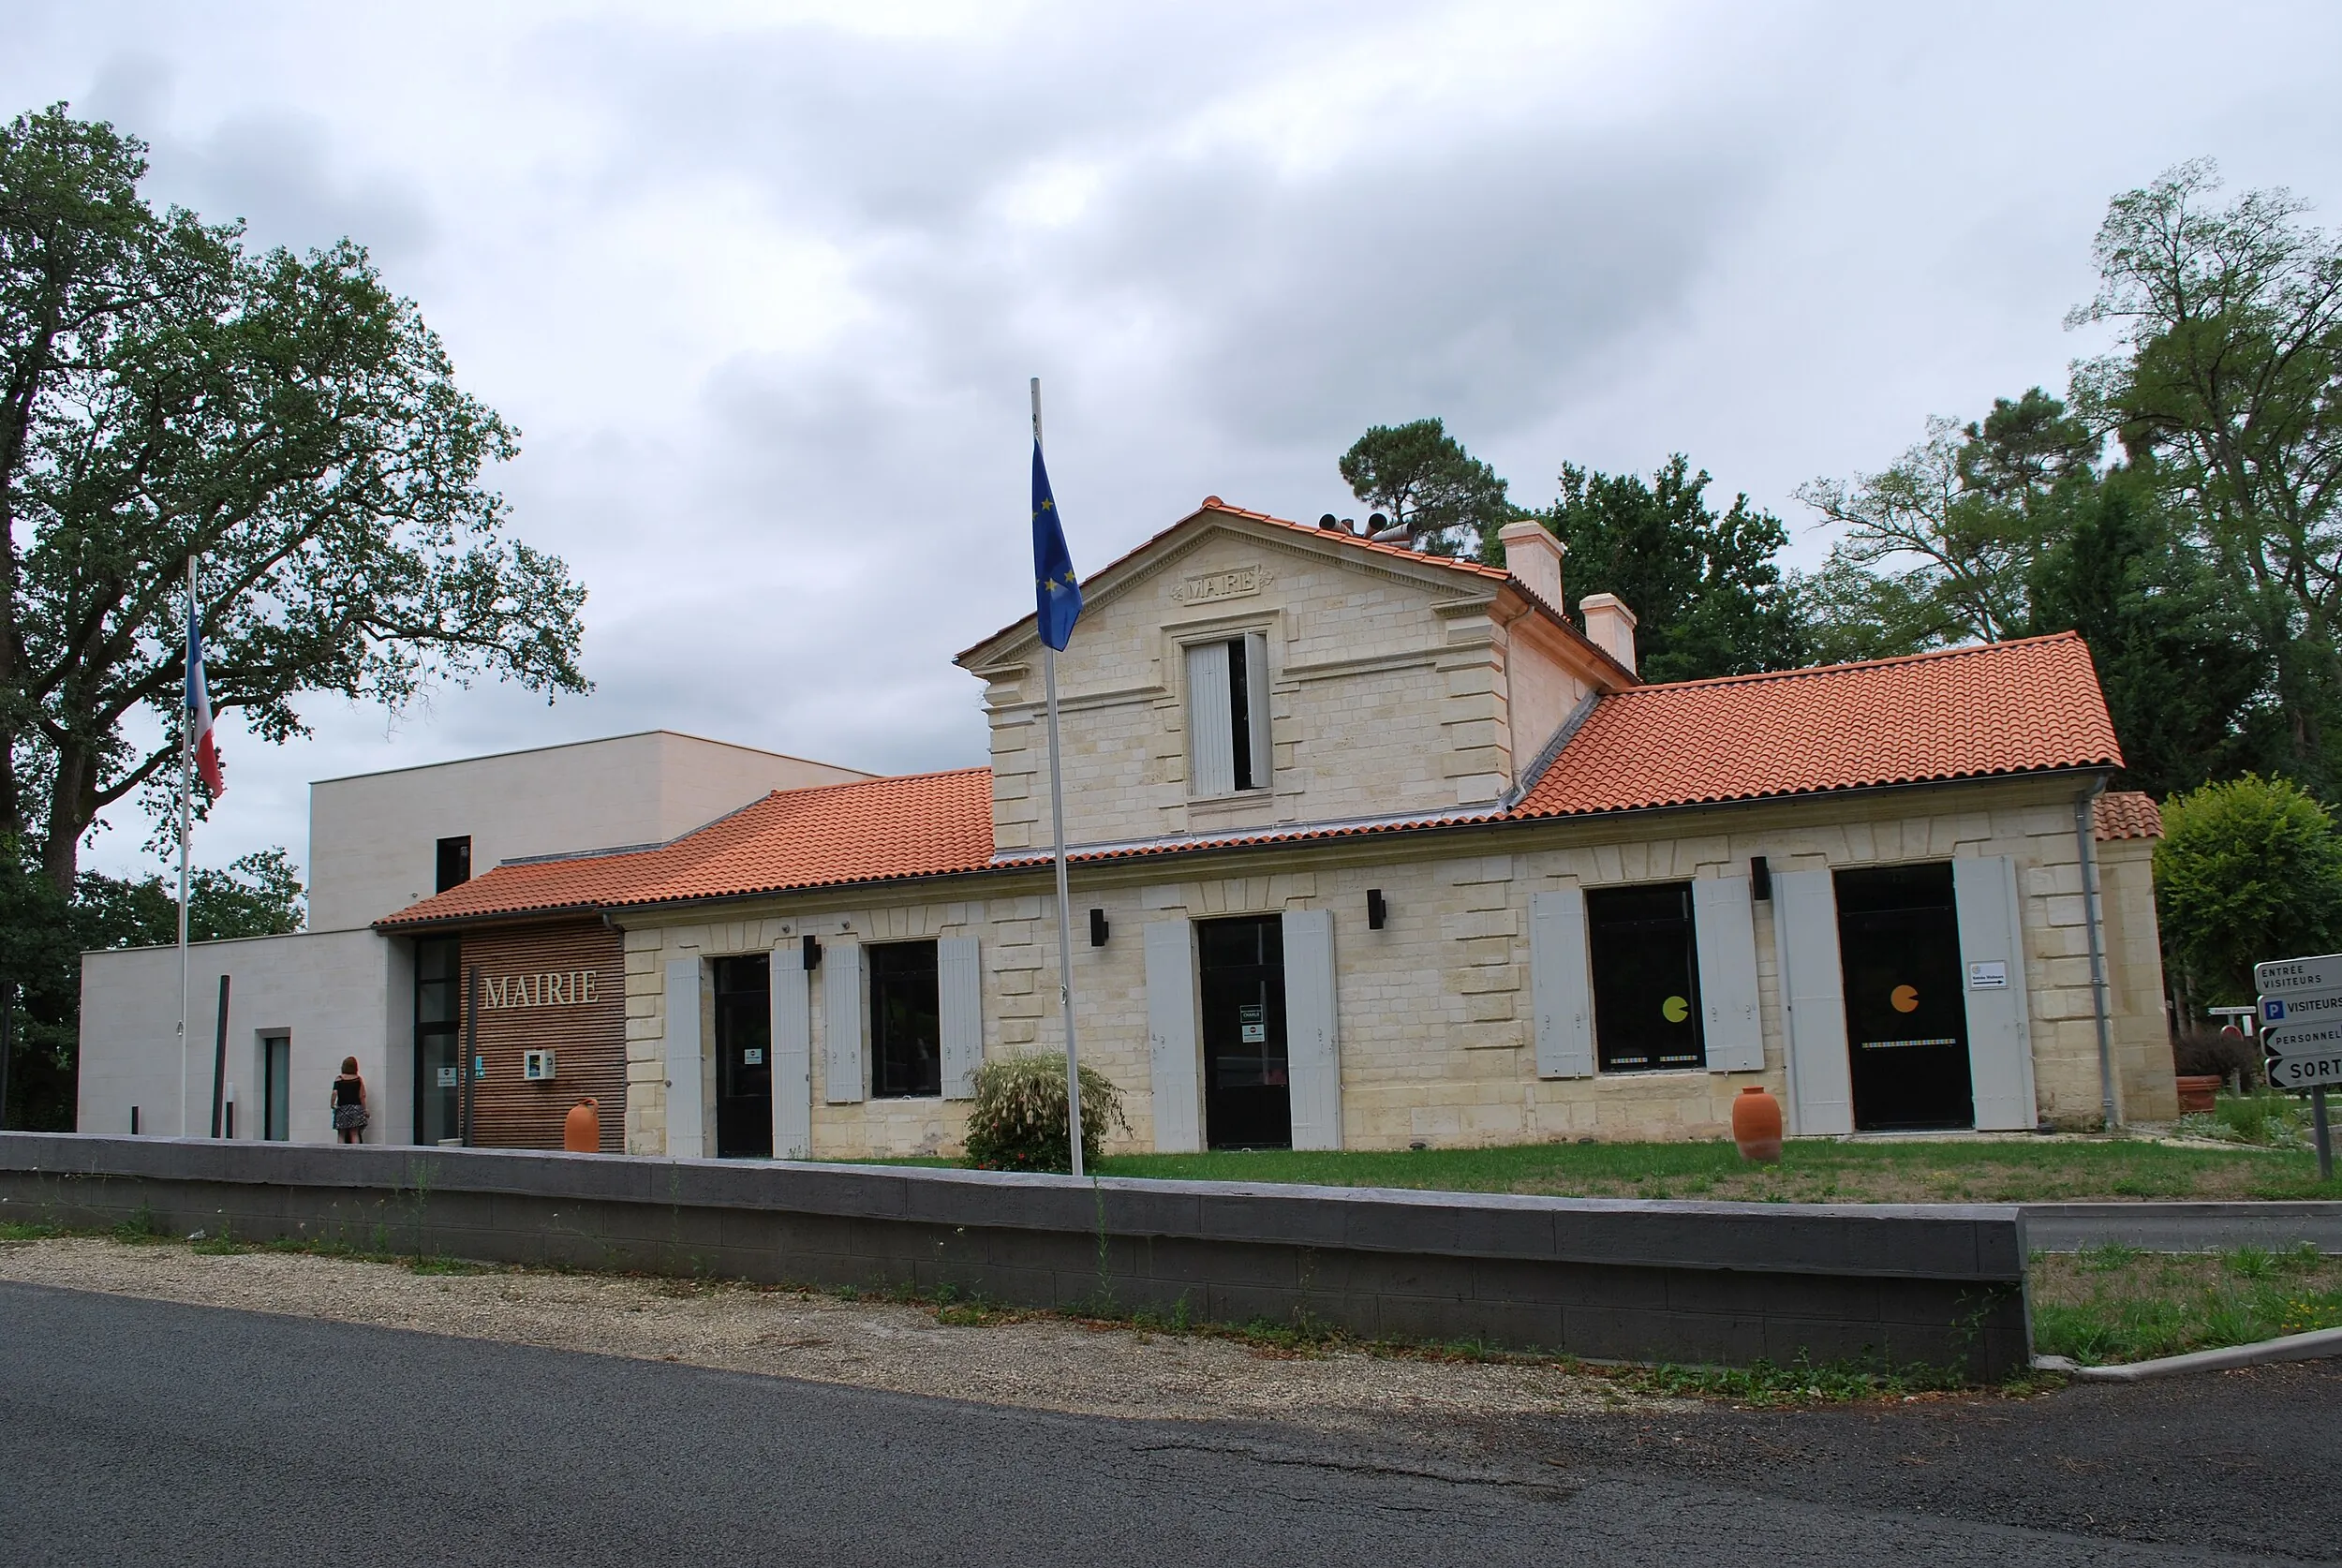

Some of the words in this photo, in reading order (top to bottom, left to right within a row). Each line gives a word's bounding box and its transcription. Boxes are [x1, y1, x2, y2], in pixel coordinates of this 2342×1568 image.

[1188, 570, 1255, 599] MAIRIE
[2261, 965, 2305, 978] ENTRÉE
[2263, 974, 2322, 989] VISITEURS
[483, 970, 600, 1010] MAIRIE
[2268, 1004, 2279, 1018] P
[2287, 997, 2342, 1013] VISITEURS
[2275, 1029, 2341, 1045] PERSONNEL
[2290, 1058, 2342, 1079] SORT
